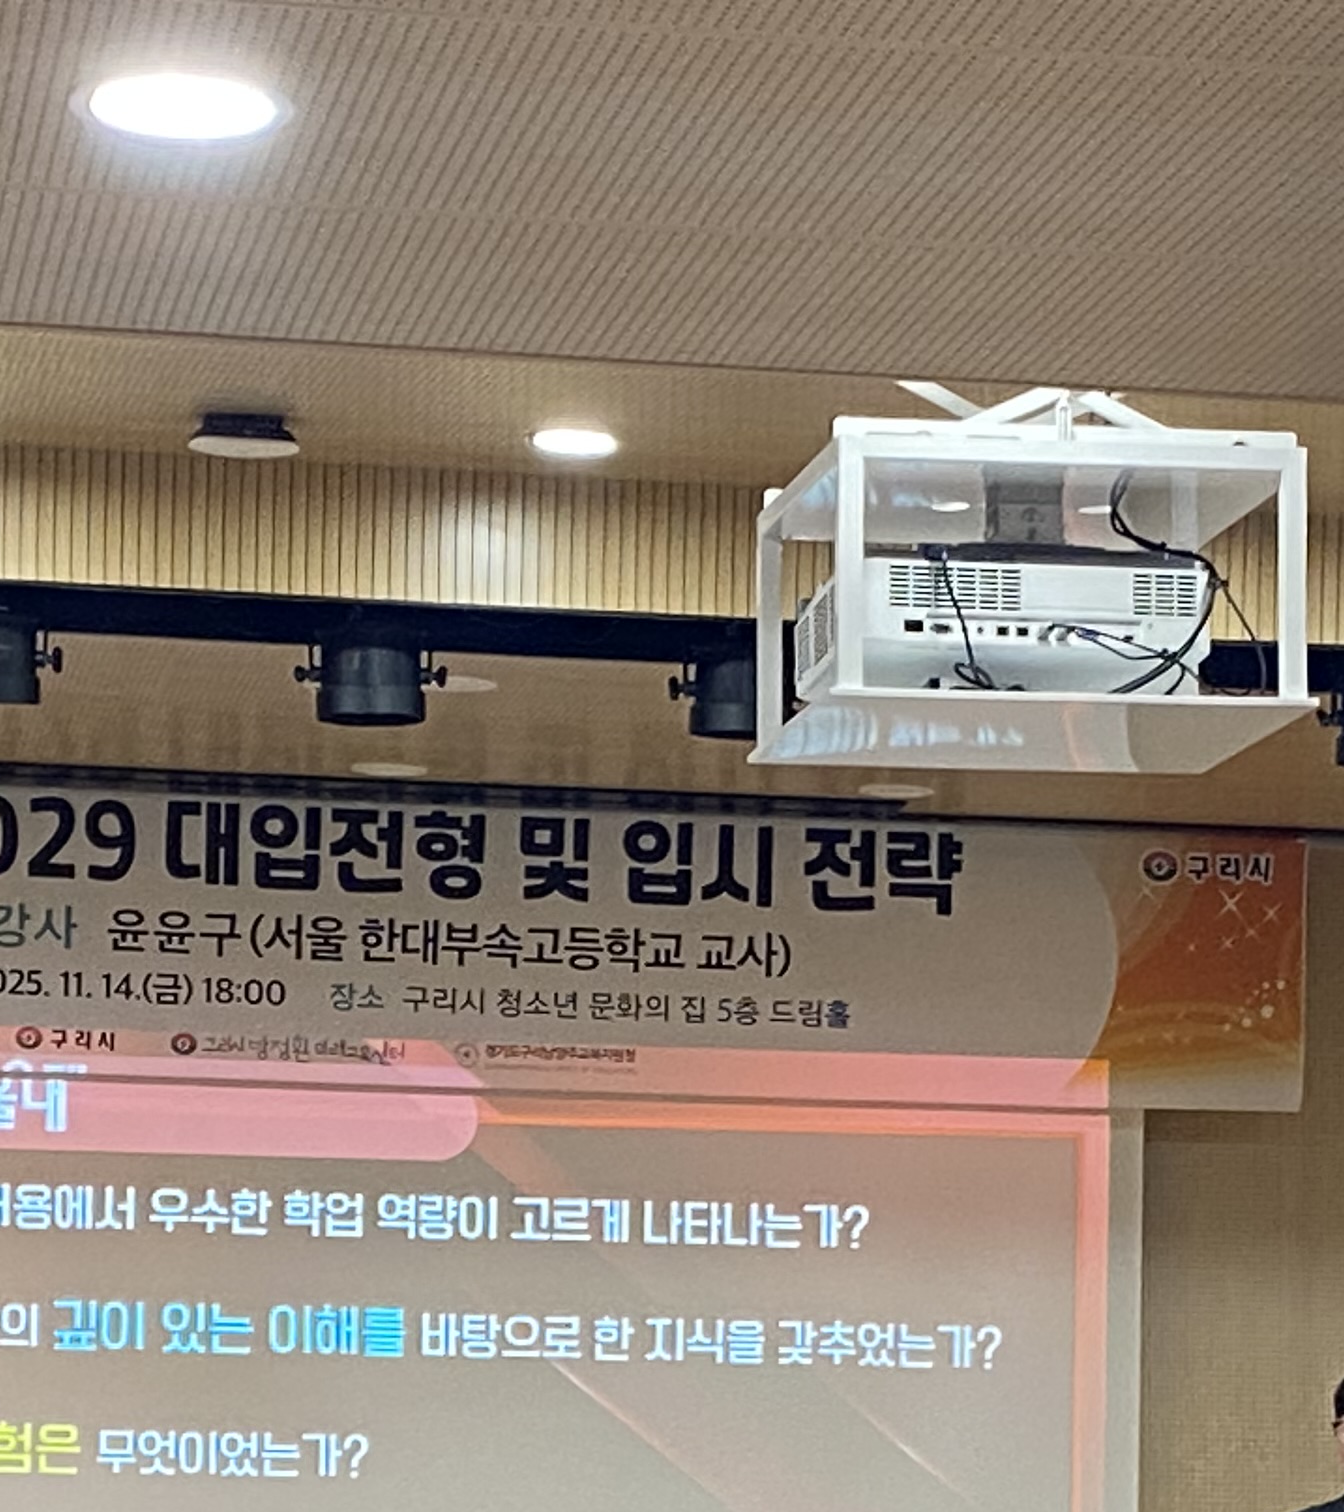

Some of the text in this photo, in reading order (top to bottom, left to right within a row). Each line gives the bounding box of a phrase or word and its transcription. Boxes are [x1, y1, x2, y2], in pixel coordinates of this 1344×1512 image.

[164, 799, 487, 900] 대입전형
[519, 815, 591, 904] 및
[622, 819, 775, 908] 입시
[804, 826, 964, 917] 전략
[1187, 856, 1271, 884] 구리시
[107, 907, 348, 962] 윤윤구(서울
[358, 916, 686, 974] 한대부속고등학교
[696, 930, 792, 979] 교사)
[202, 976, 286, 1006] 18:00
[329, 982, 386, 1012] 장소
[402, 986, 486, 1015] 구리시
[497, 989, 579, 1020] 청소년
[589, 992, 670, 1023] 문화의
[680, 995, 706, 1024] 집
[716, 998, 759, 1026] 5층
[768, 1000, 852, 1029] 드림홀
[51, 1030, 115, 1052] 구리시
[148, 1186, 273, 1236] 우수한
[283, 1189, 364, 1239] 학업
[376, 1192, 498, 1241] 역량이
[510, 1196, 630, 1244] 고르게
[642, 1199, 870, 1250] 나타나는가?
[53, 1297, 146, 1351] 깊이
[161, 1301, 254, 1355] 있는
[268, 1303, 406, 1358] 이해를
[421, 1311, 583, 1360] 바탕으로
[593, 1314, 635, 1362] 한
[644, 1316, 766, 1365] 지식을
[777, 1318, 1003, 1370] 갖추었는가?
[96, 1427, 370, 1479] 무엇이었는가?
